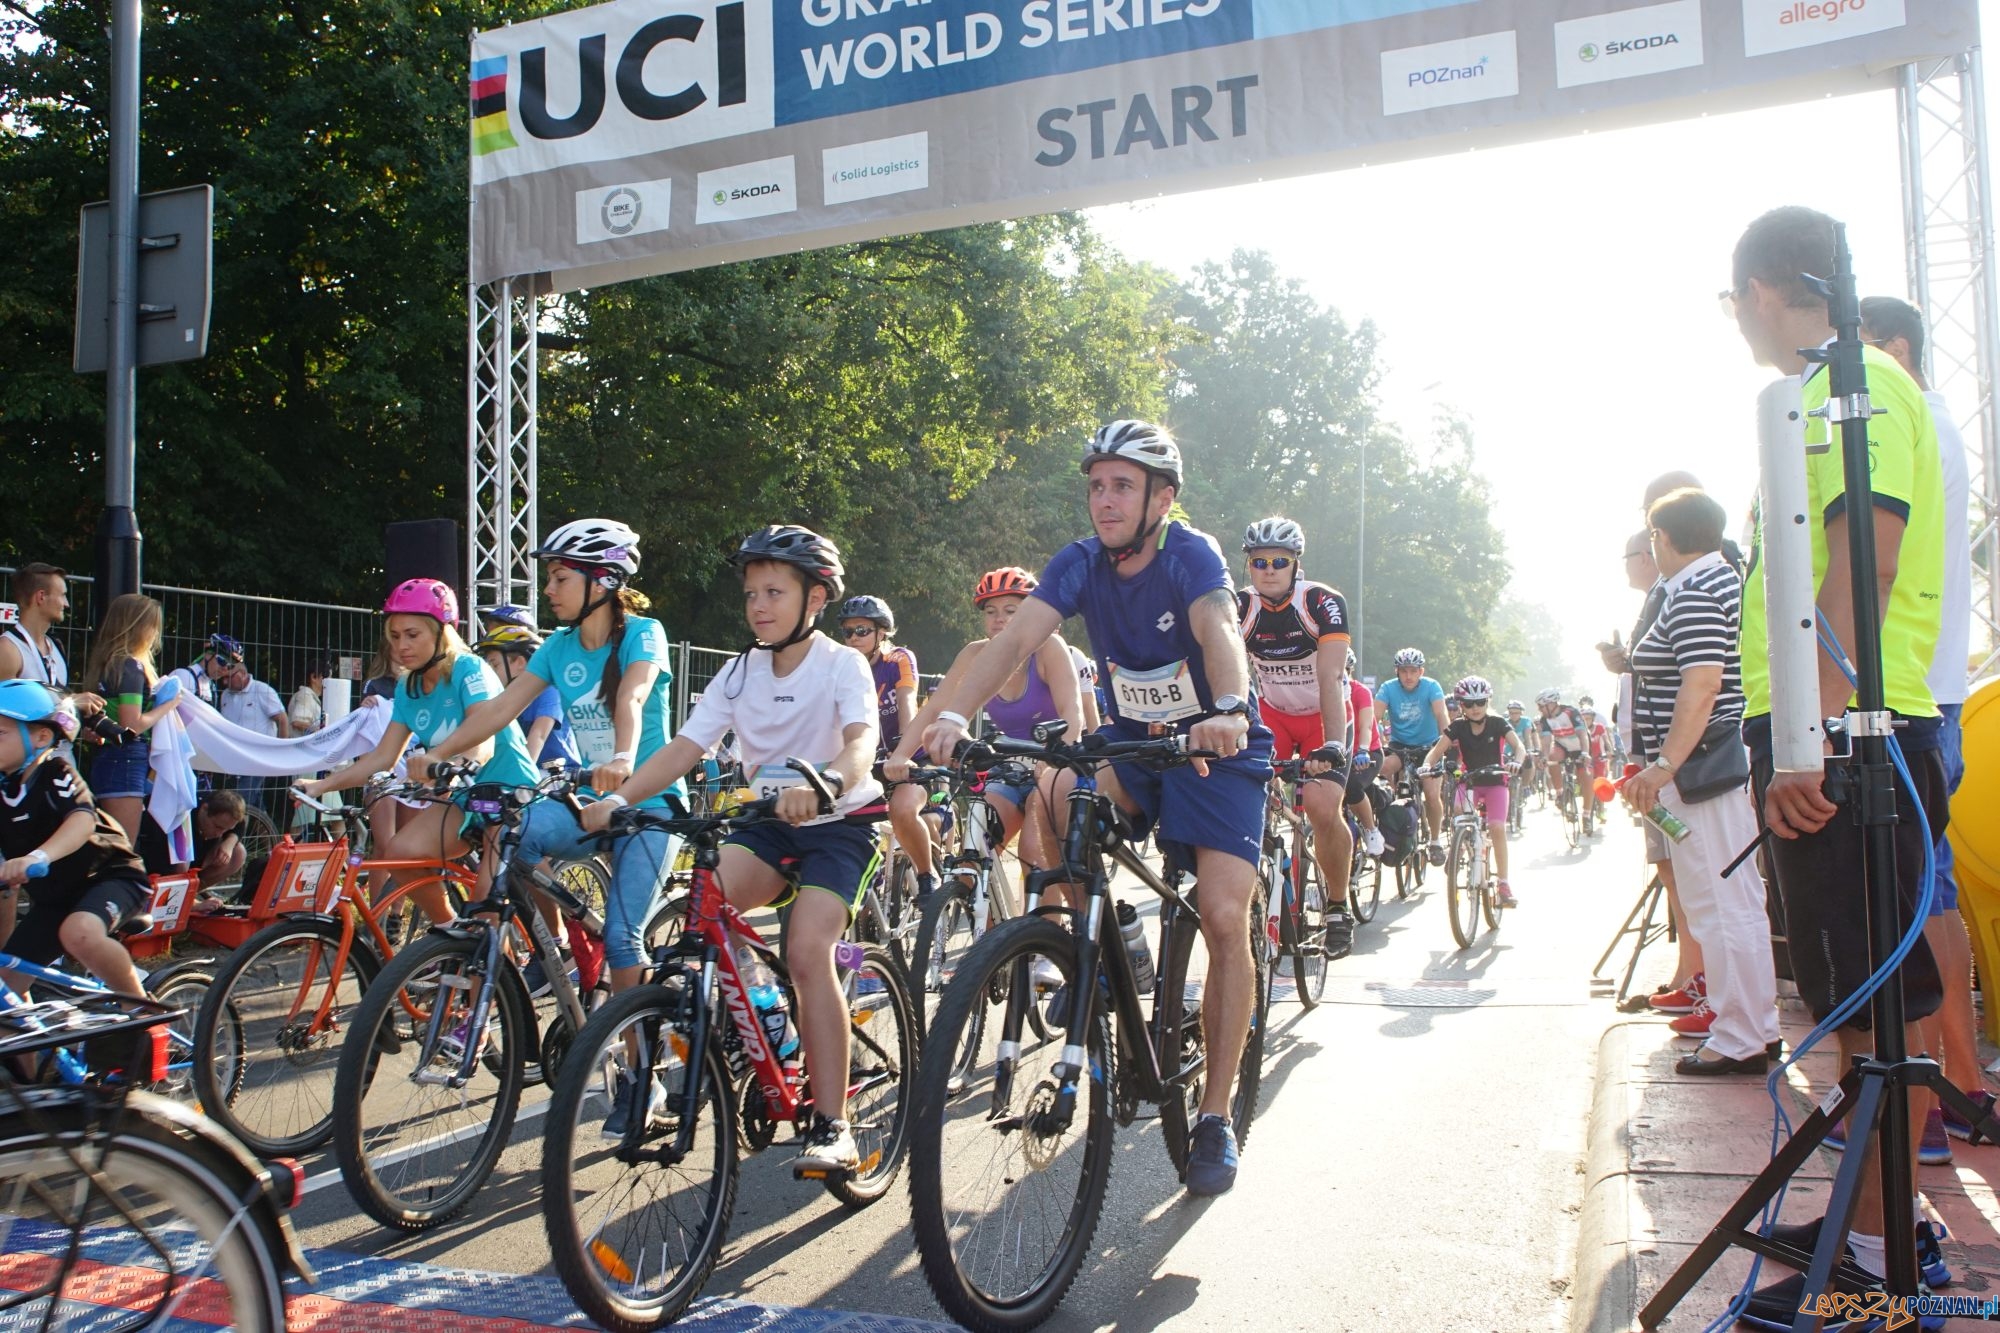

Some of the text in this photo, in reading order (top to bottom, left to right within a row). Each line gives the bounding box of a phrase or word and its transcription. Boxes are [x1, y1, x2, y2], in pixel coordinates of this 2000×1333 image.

[1779, 0, 1865, 25] allegro
[800, 12, 1003, 91] WORLD
[1605, 34, 1679, 55] ŠKODA
[519, 2, 747, 140] UCI
[1035, 74, 1259, 167] START
[841, 158, 920, 182] Solid Logistics
[731, 183, 781, 200] ŠKODA
[613, 203, 630, 212] BIKE
[716, 970, 767, 1062] GIANT
